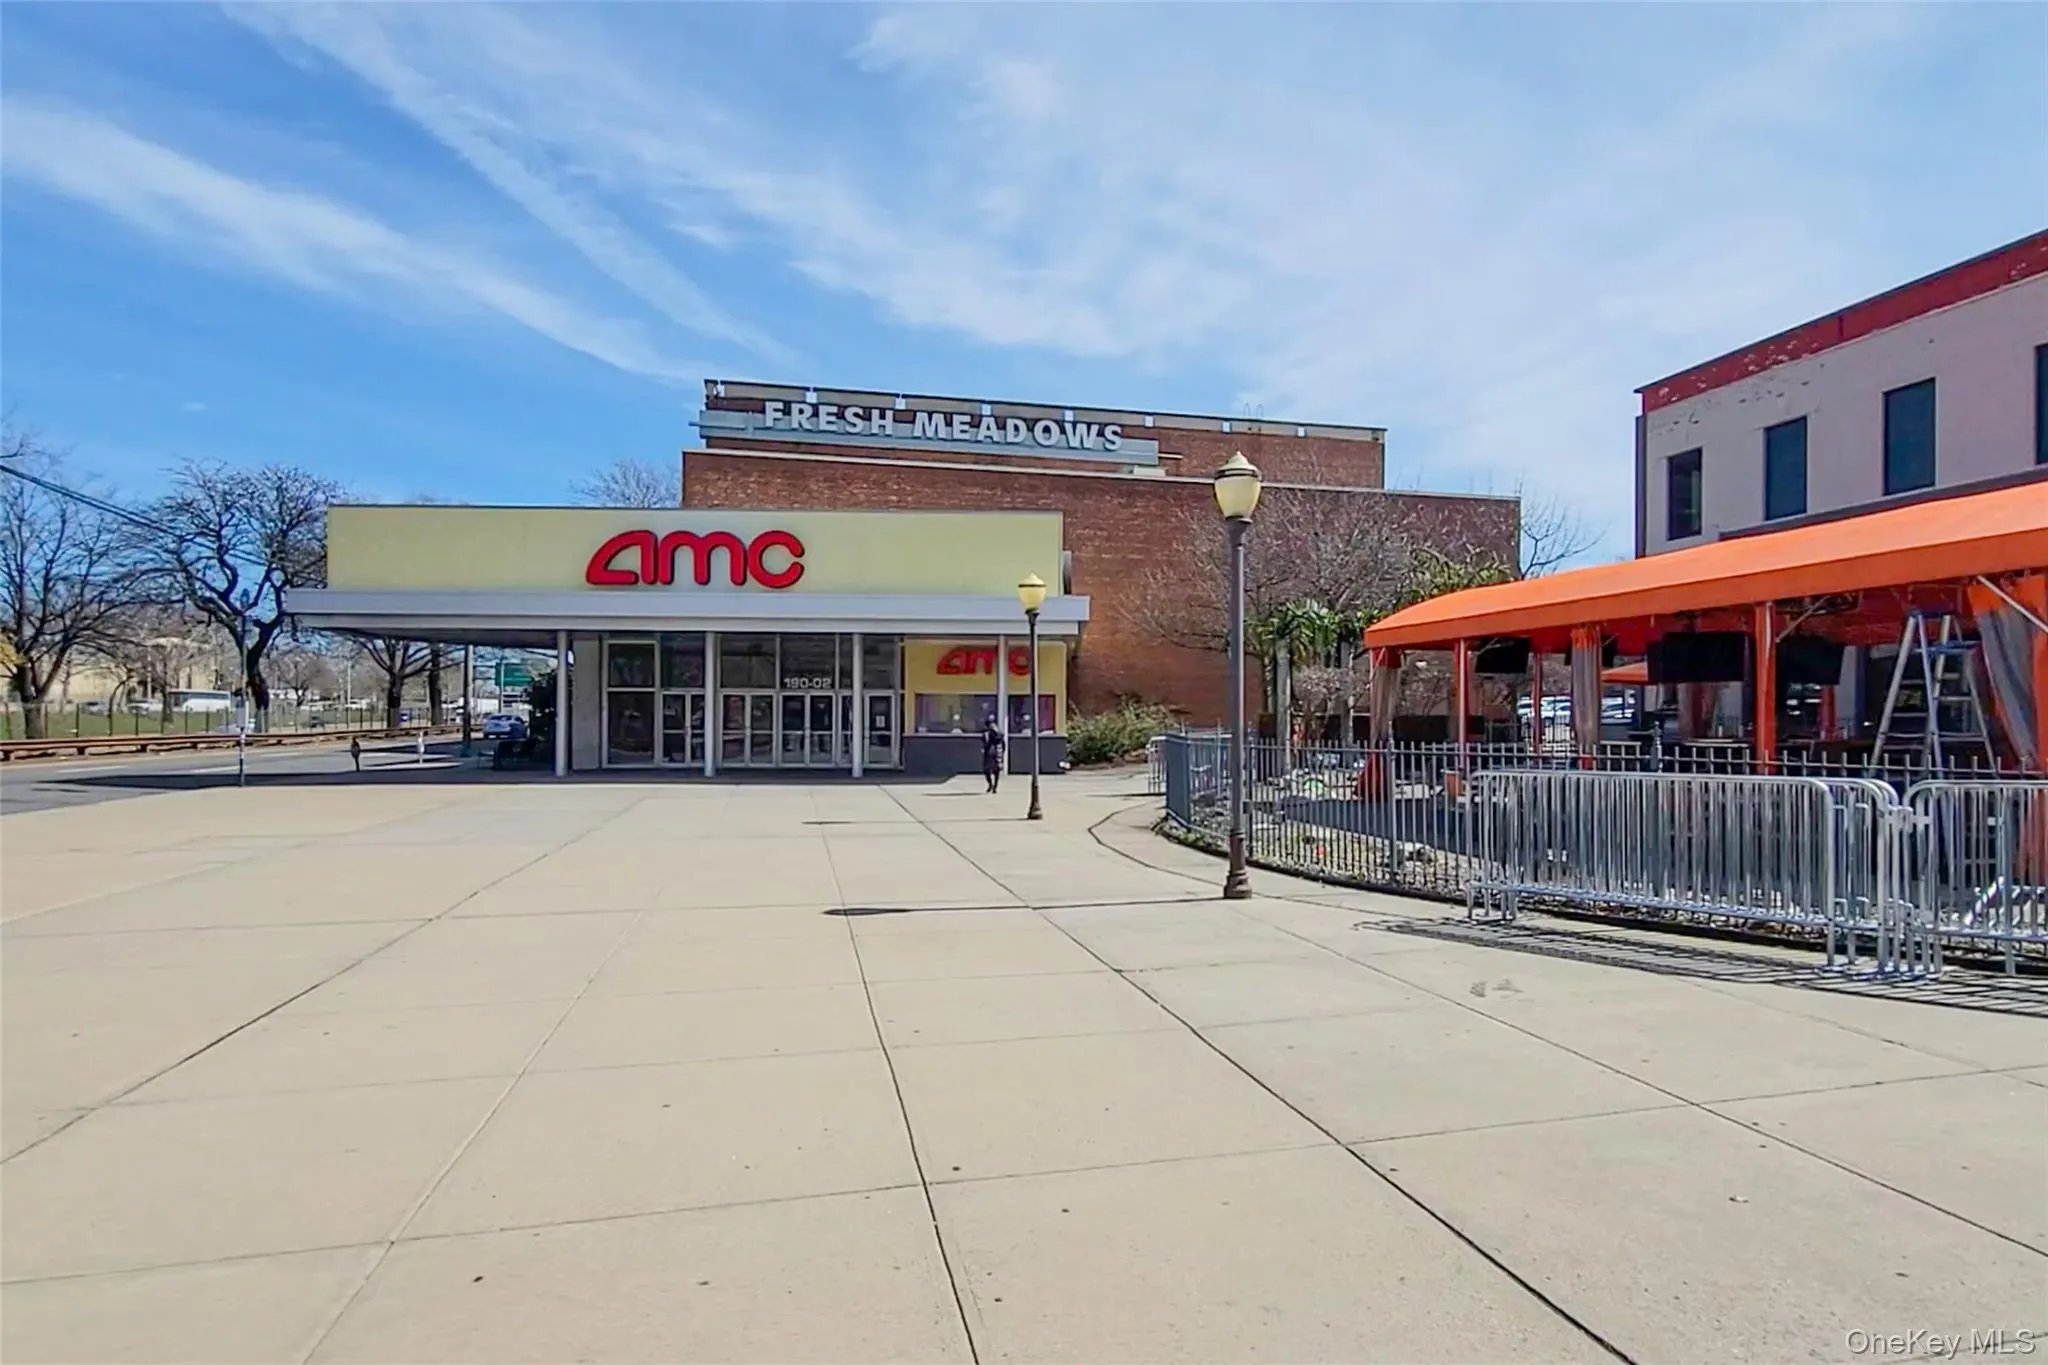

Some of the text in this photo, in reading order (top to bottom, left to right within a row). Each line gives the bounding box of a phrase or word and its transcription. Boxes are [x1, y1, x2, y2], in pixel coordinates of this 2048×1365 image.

[764, 401, 1123, 451] FRESH MEADOWS
[784, 676, 832, 689] 190-02
